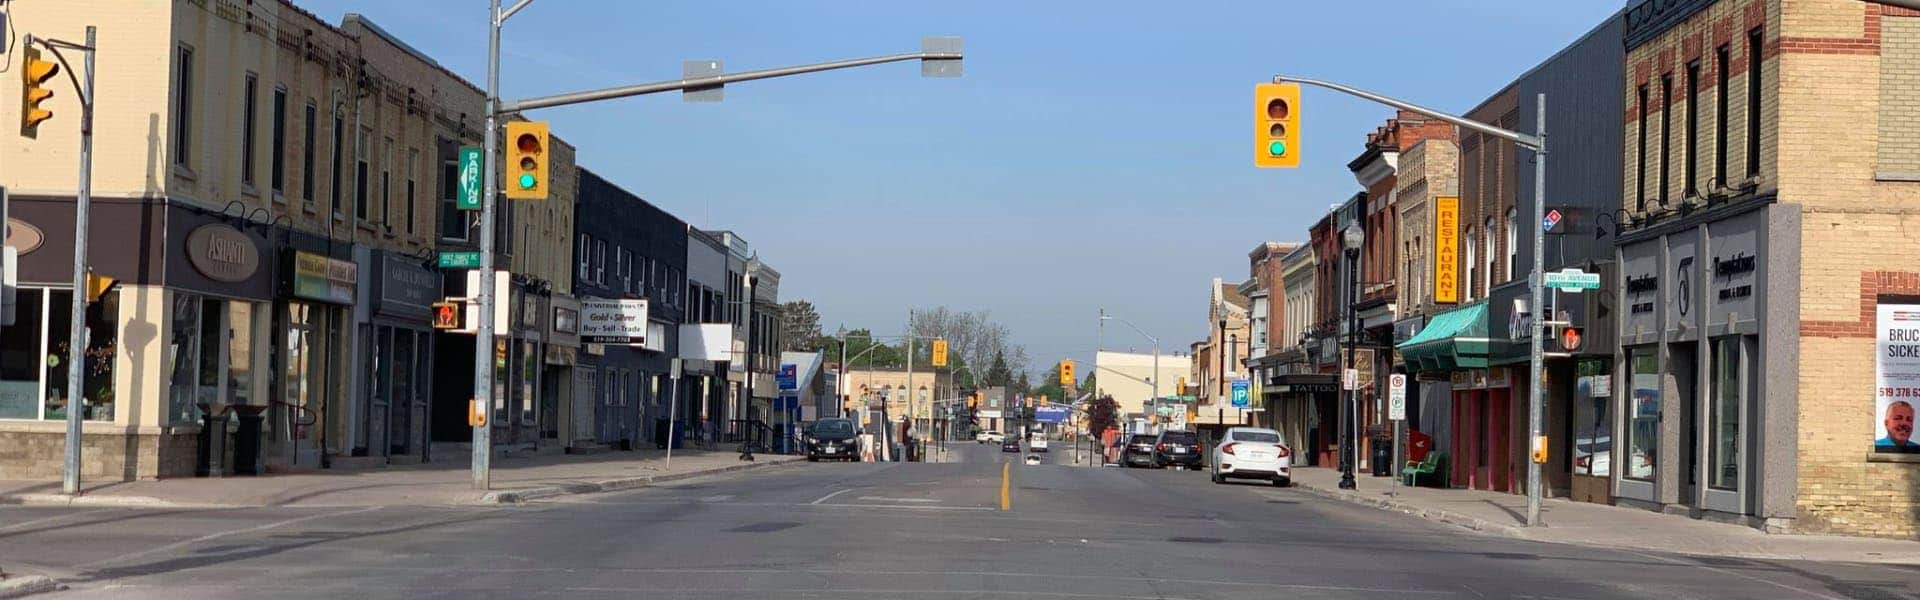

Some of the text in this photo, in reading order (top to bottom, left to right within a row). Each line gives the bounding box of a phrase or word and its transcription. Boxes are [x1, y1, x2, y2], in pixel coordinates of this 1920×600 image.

[468, 152, 478, 204] PARKING
[1441, 211, 1453, 297] RESTAURANT
[590, 313, 636, 321] Gold Silver
[583, 325, 597, 333] Buy
[602, 324, 616, 332] Sell
[1295, 384, 1337, 392] TATTOO
[1879, 387, 1894, 397] 519
[1895, 387, 1911, 397] 378
